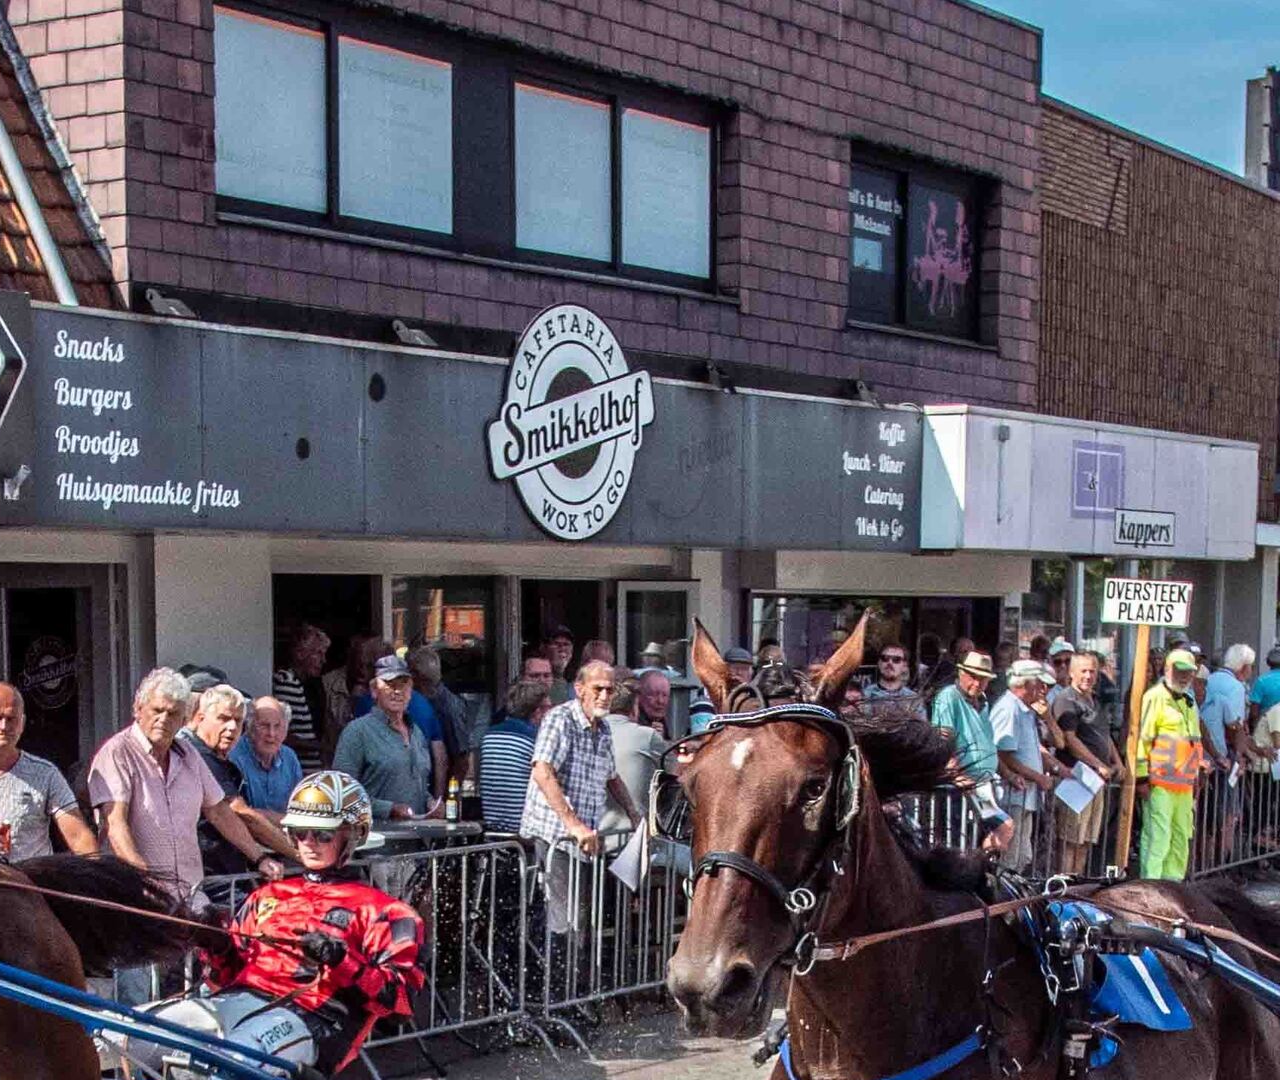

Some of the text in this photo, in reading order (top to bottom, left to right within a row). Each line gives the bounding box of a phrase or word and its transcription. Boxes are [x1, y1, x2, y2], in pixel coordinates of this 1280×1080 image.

[54, 331, 125, 363] Snacks
[515, 314, 615, 390] CAFETARIA
[54, 378, 133, 416] Burgers
[503, 378, 642, 468] Smikkelhof
[879, 421, 906, 446] Koffie
[55, 425, 140, 463] Broodjes
[842, 451, 870, 475] Lunch
[878, 453, 906, 474] Diner
[56, 473, 241, 513] Huisgemaakte frites
[542, 470, 625, 533] WOK TO GO
[865, 485, 904, 511] Catering
[855, 517, 905, 541] Wok to Go
[1118, 513, 1171, 548] kappers
[1106, 580, 1188, 603] OVERSTEEK
[1118, 602, 1175, 623] PLAATS
